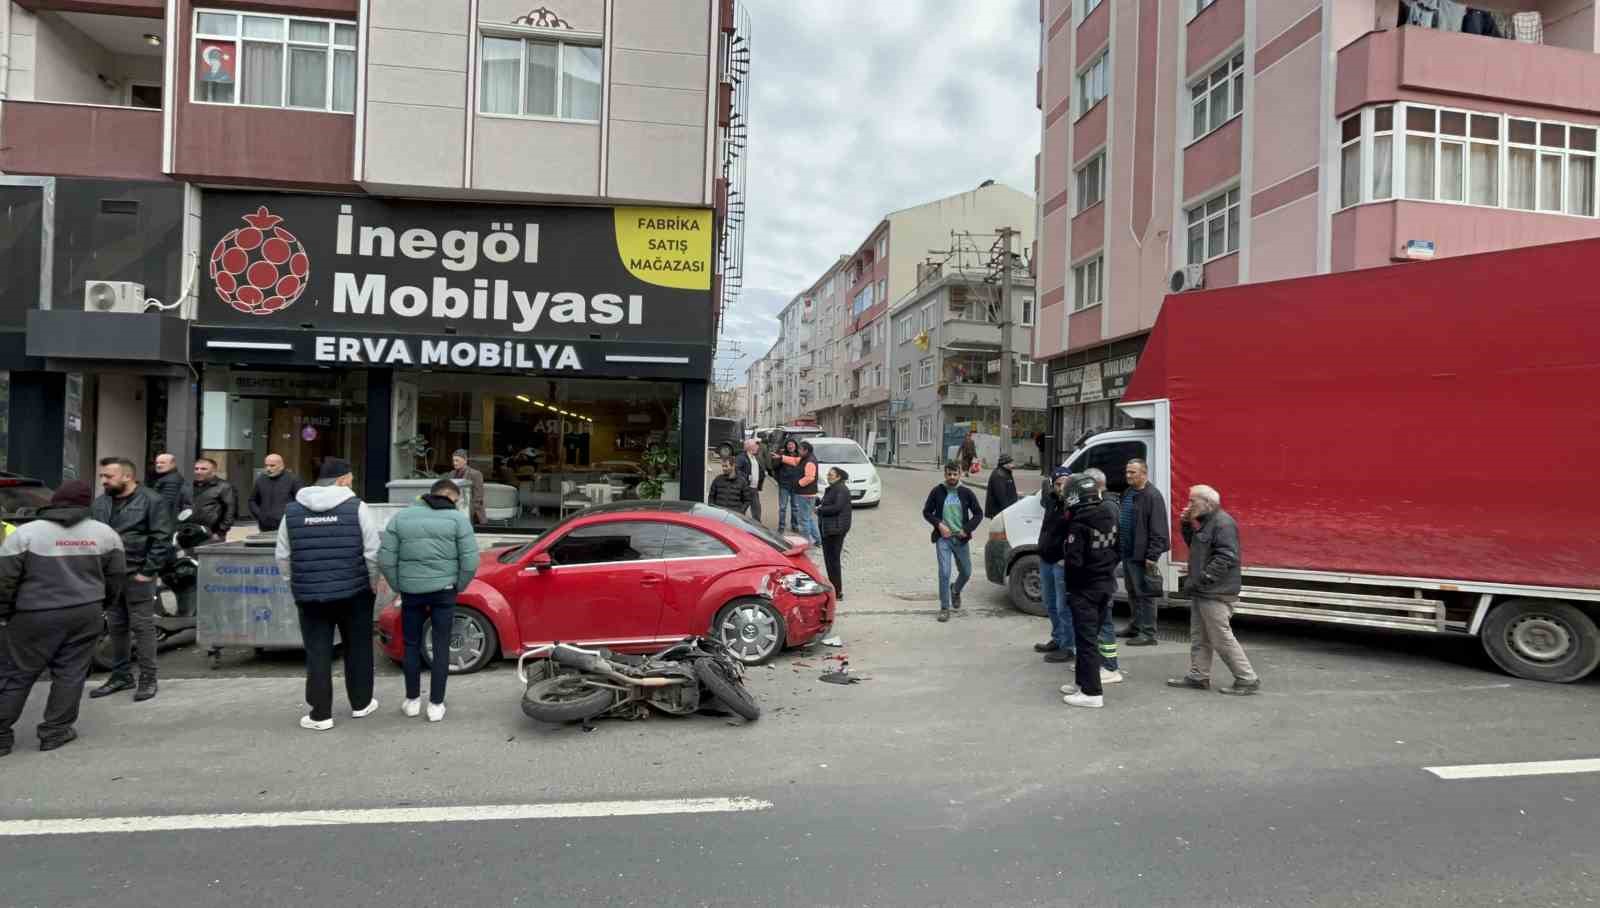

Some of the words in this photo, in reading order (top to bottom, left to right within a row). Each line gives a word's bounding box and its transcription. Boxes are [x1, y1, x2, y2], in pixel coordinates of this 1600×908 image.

[638, 216, 700, 231] FABRİKA
[336, 204, 539, 271] İnegöl
[648, 238, 688, 254] SATIŞ
[629, 257, 705, 272] MAĞAZASI
[333, 272, 643, 332] Mobilyası
[315, 336, 414, 365] ERVA
[422, 342, 583, 370] MOBİLYA
[55, 539, 97, 547] HONDA
